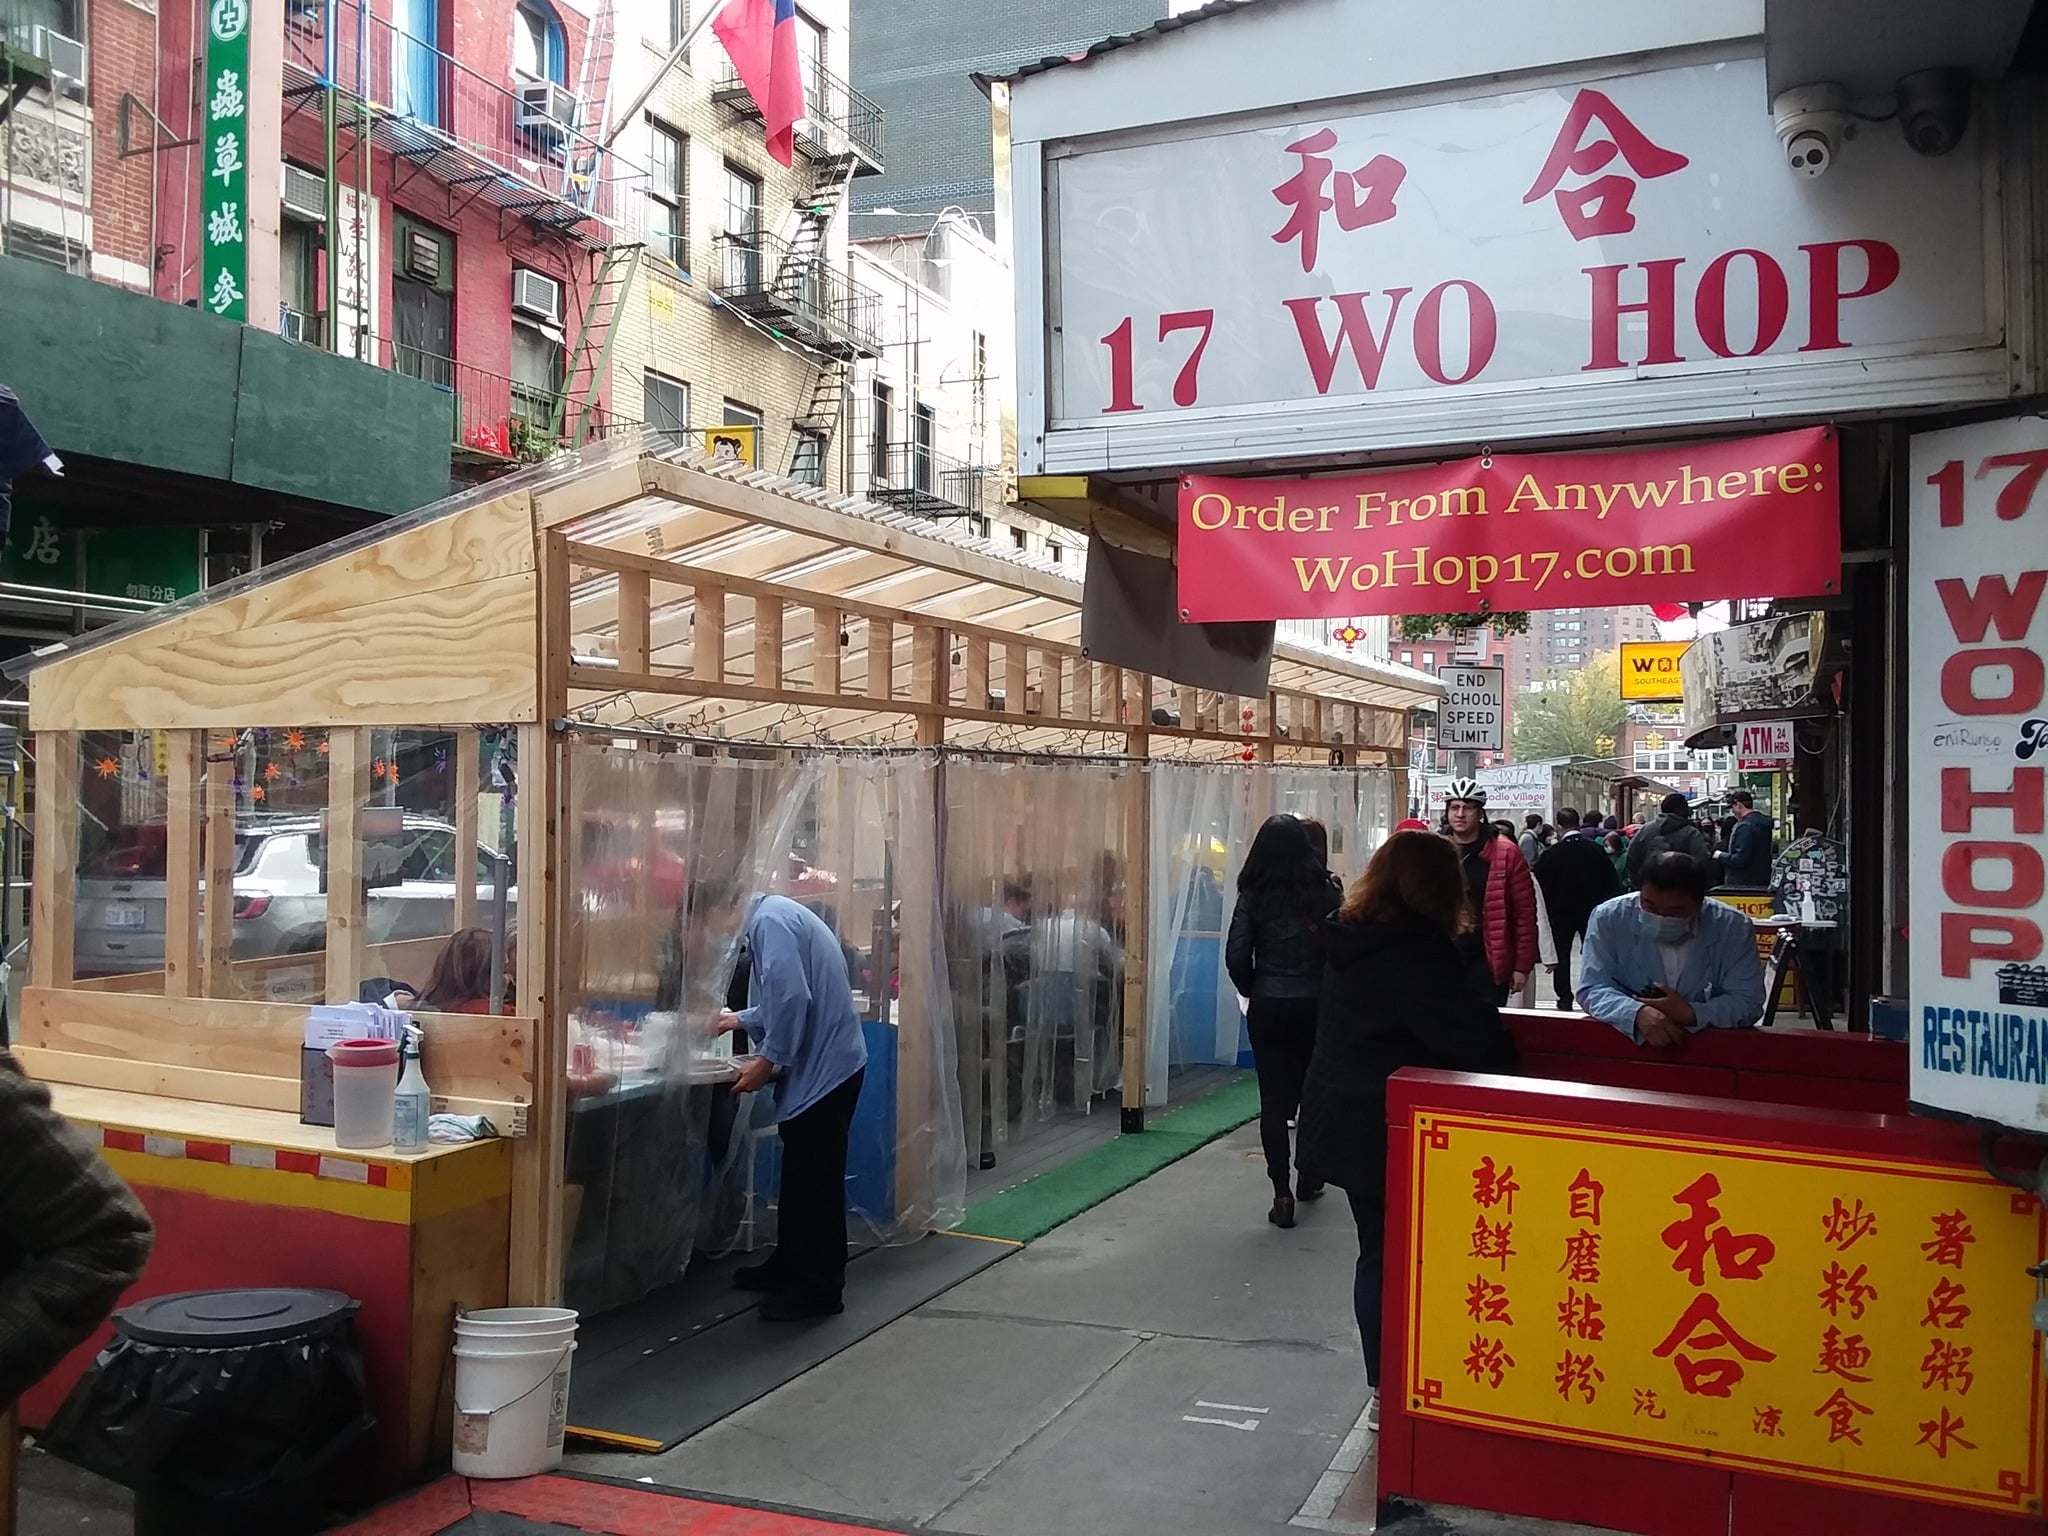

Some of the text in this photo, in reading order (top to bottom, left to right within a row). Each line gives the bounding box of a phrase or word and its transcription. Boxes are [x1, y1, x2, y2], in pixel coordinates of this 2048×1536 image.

[1101, 238, 1900, 413] 17 WO HOP
[1191, 460, 1825, 533] Order From Anywhere:
[1927, 447, 2048, 528] 17
[1292, 542, 1695, 594] WoHop17.com
[1934, 569, 2048, 716] WO
[1457, 674, 1486, 687] END
[1441, 692, 1501, 706] SCHOOL
[1447, 711, 1495, 725] SPEED
[1452, 730, 1489, 743] LIMIT
[1742, 726, 1773, 755] ATM
[1776, 727, 1786, 739] 24
[1774, 742, 1790, 754] HRS
[1940, 766, 2046, 978] HOP
[1736, 903, 1768, 915] HOP
[1652, 1172, 1777, 1399] 和合
